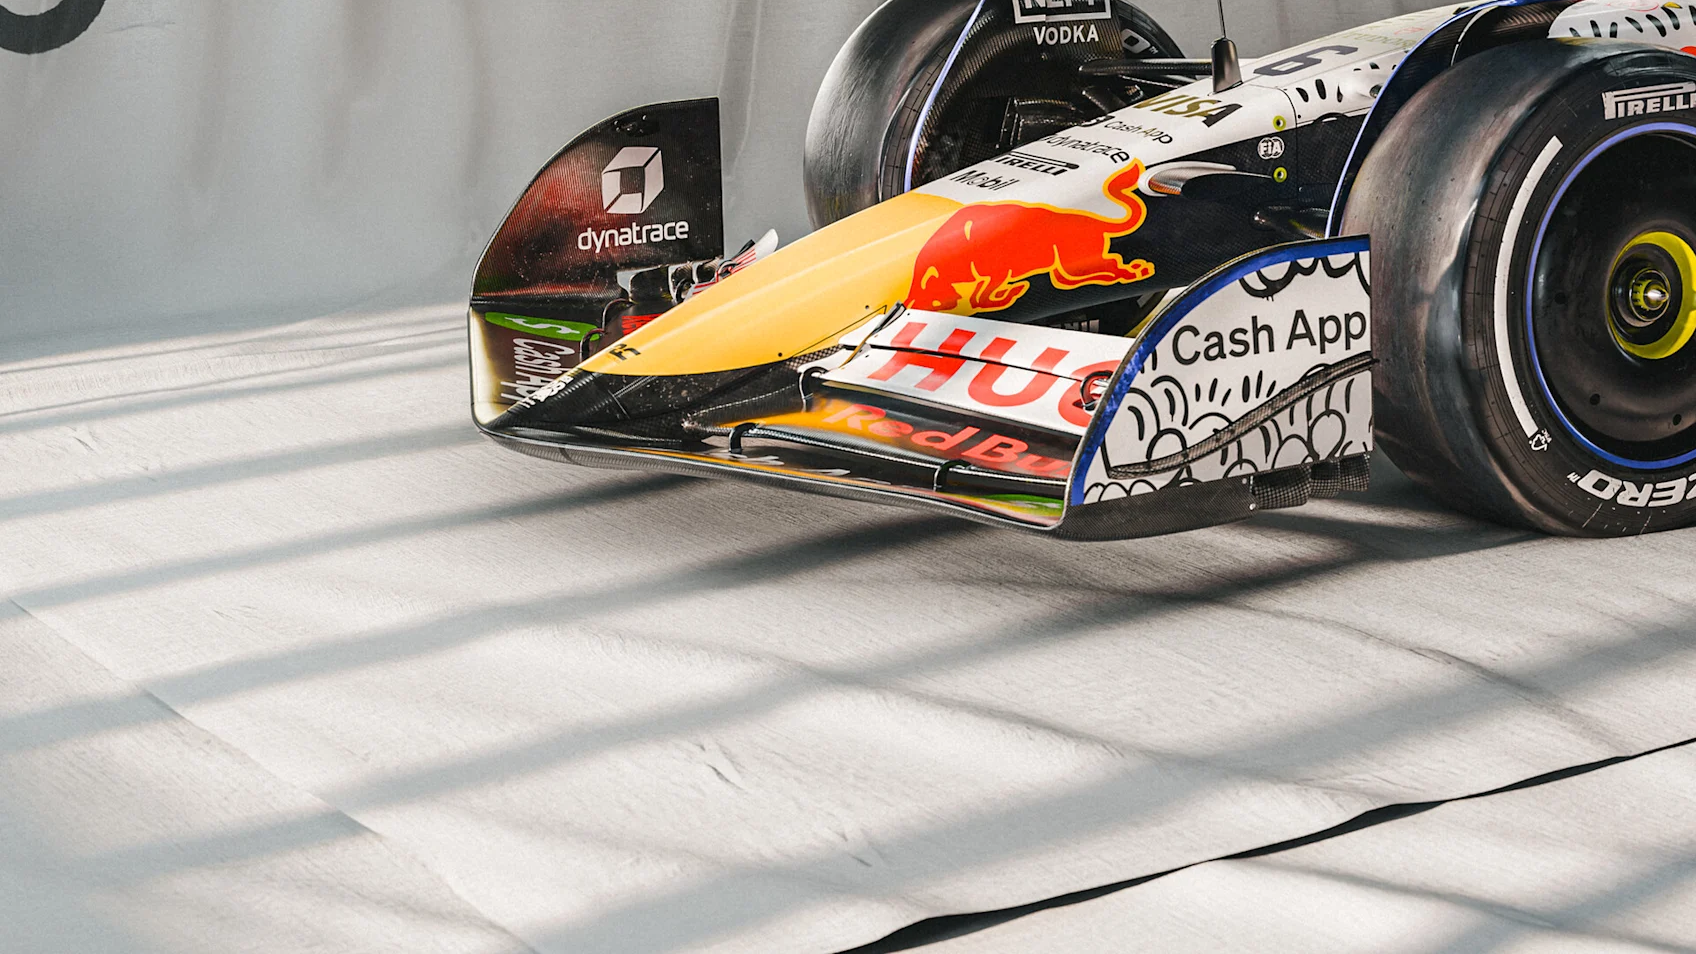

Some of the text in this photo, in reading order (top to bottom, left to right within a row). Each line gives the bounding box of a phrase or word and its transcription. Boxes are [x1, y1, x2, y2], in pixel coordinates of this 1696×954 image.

[1033, 24, 1099, 45] VODKA
[1133, 92, 1243, 128] VISA
[949, 169, 1020, 191] Mobil
[577, 220, 689, 253] dynatrace
[1171, 309, 1367, 365] Cash App
[822, 402, 1072, 478] Red Bu
